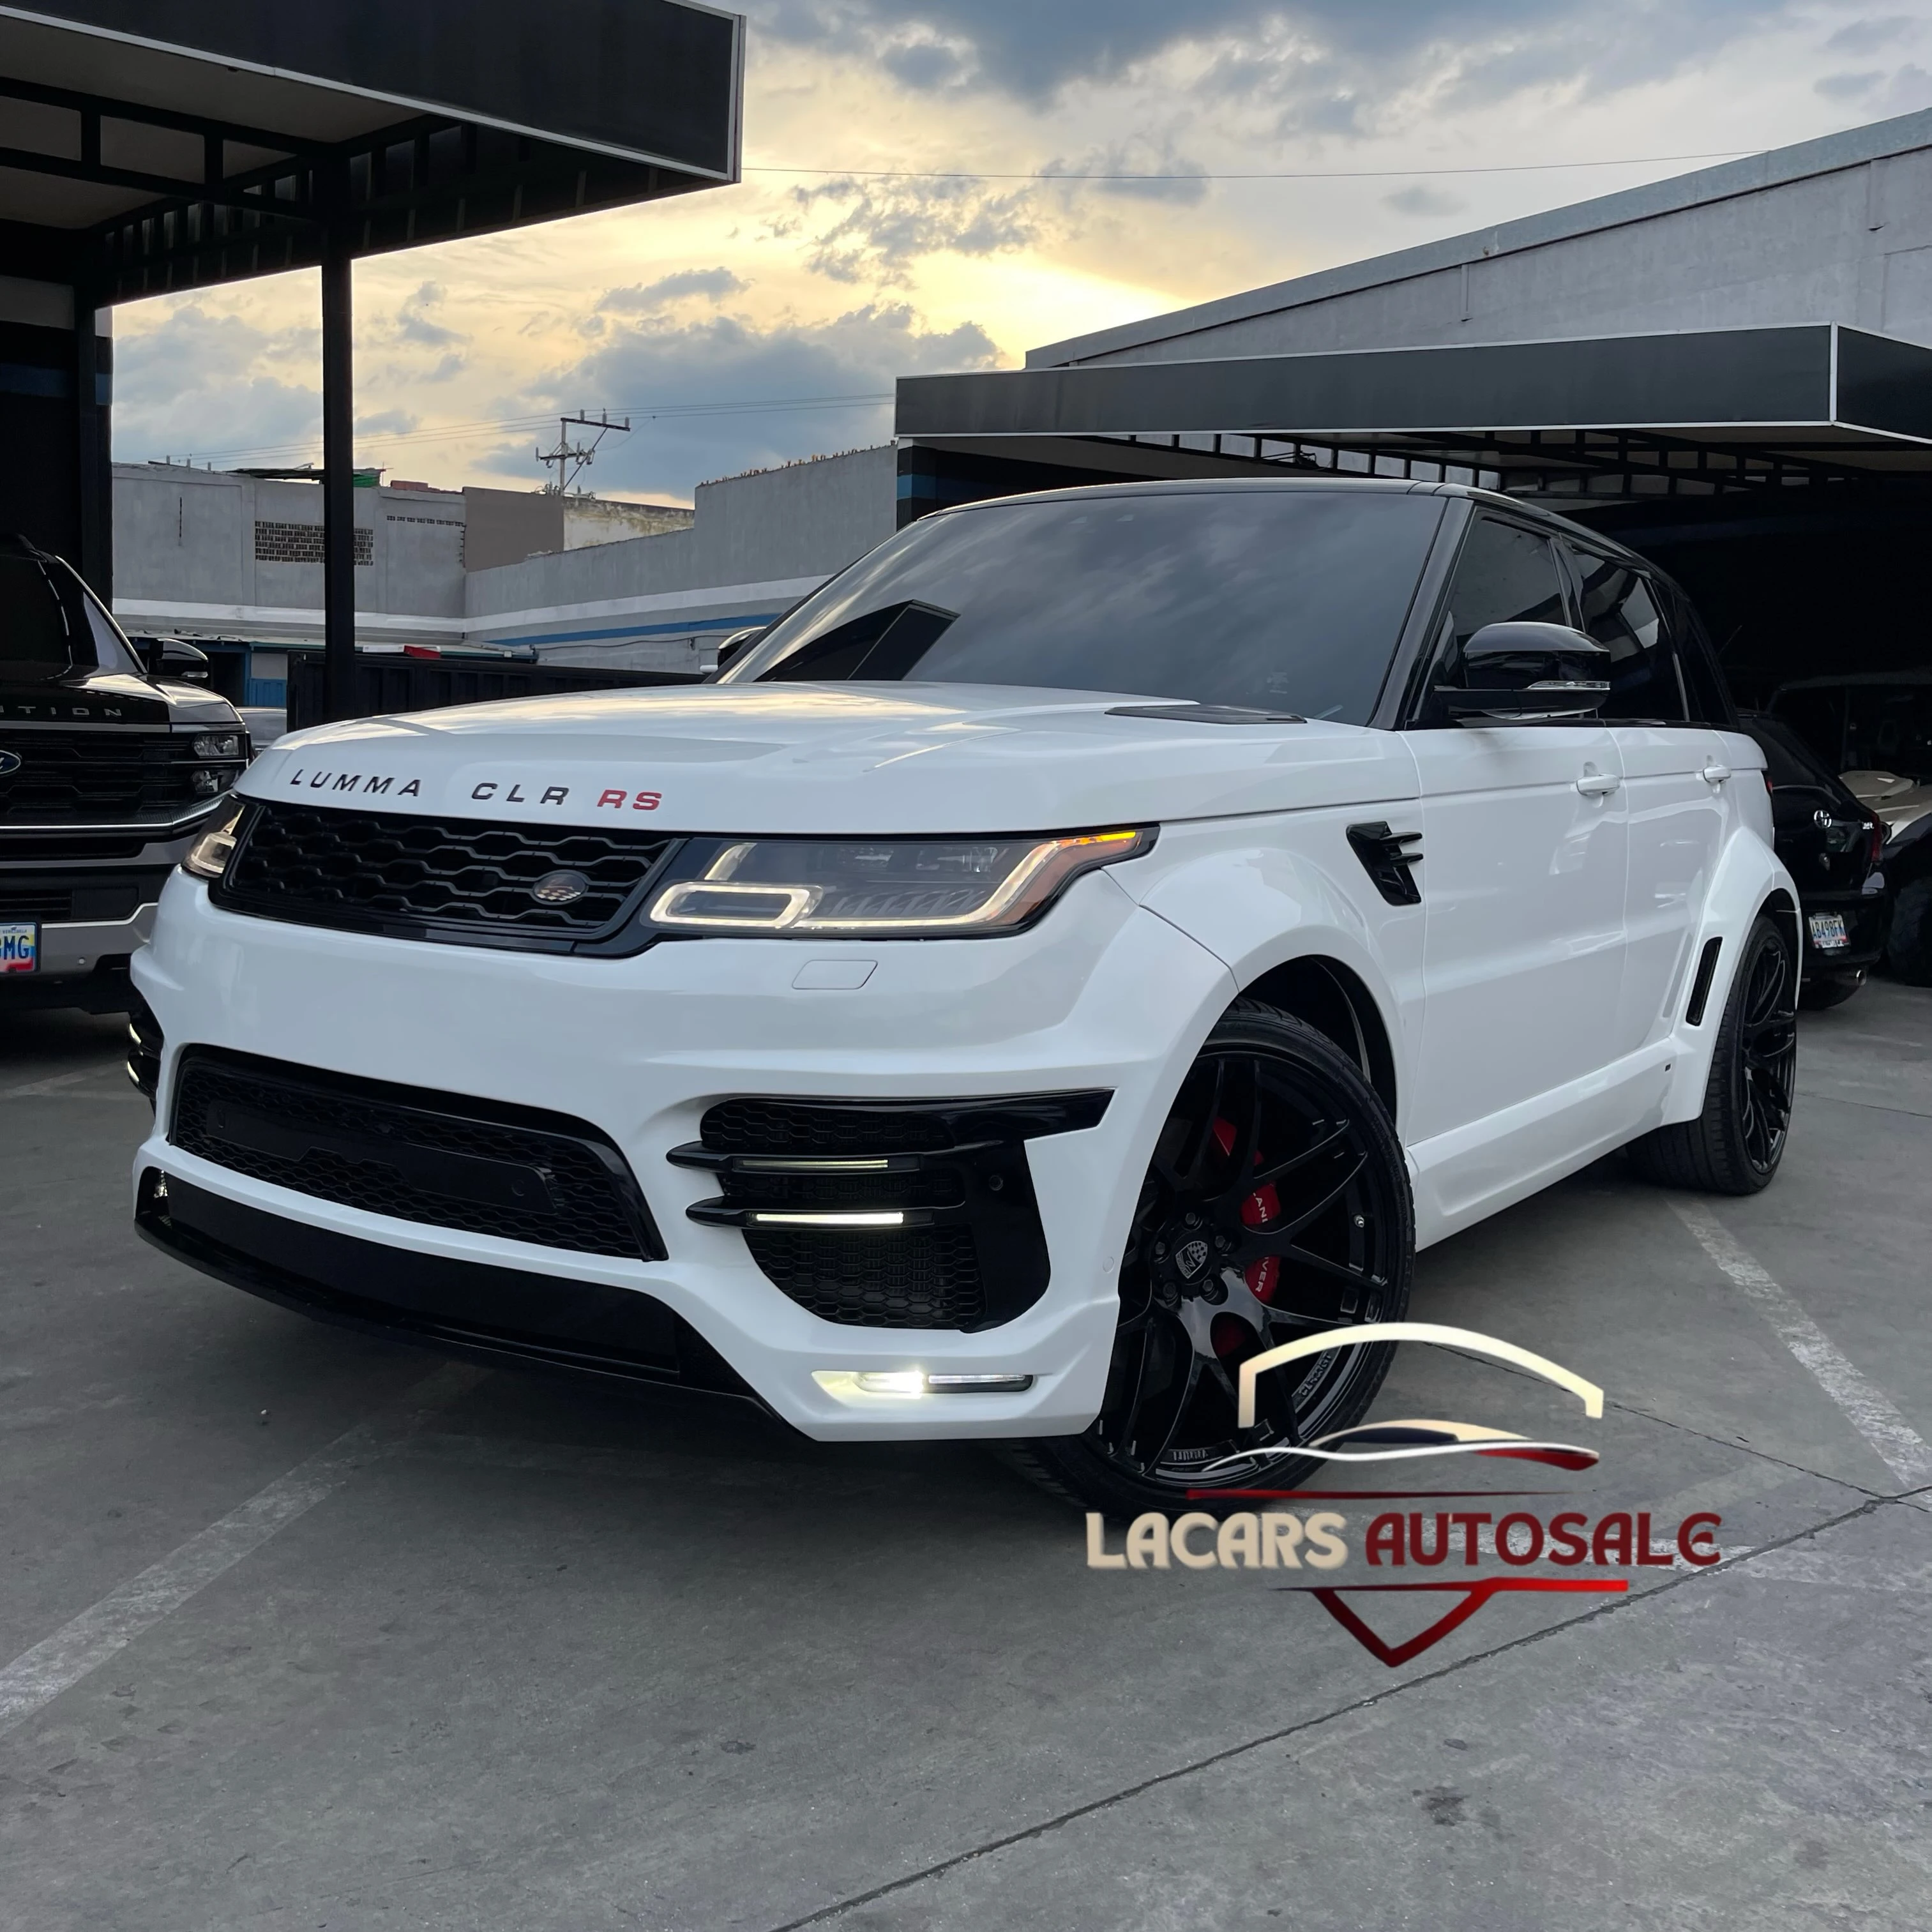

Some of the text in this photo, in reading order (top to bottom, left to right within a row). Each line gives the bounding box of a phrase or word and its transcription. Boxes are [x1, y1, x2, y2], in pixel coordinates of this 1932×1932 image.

[290, 769, 663, 811] LUMMA CLR RS
[0, 935, 29, 960] MG
[1255, 1257, 1270, 1293] VER
